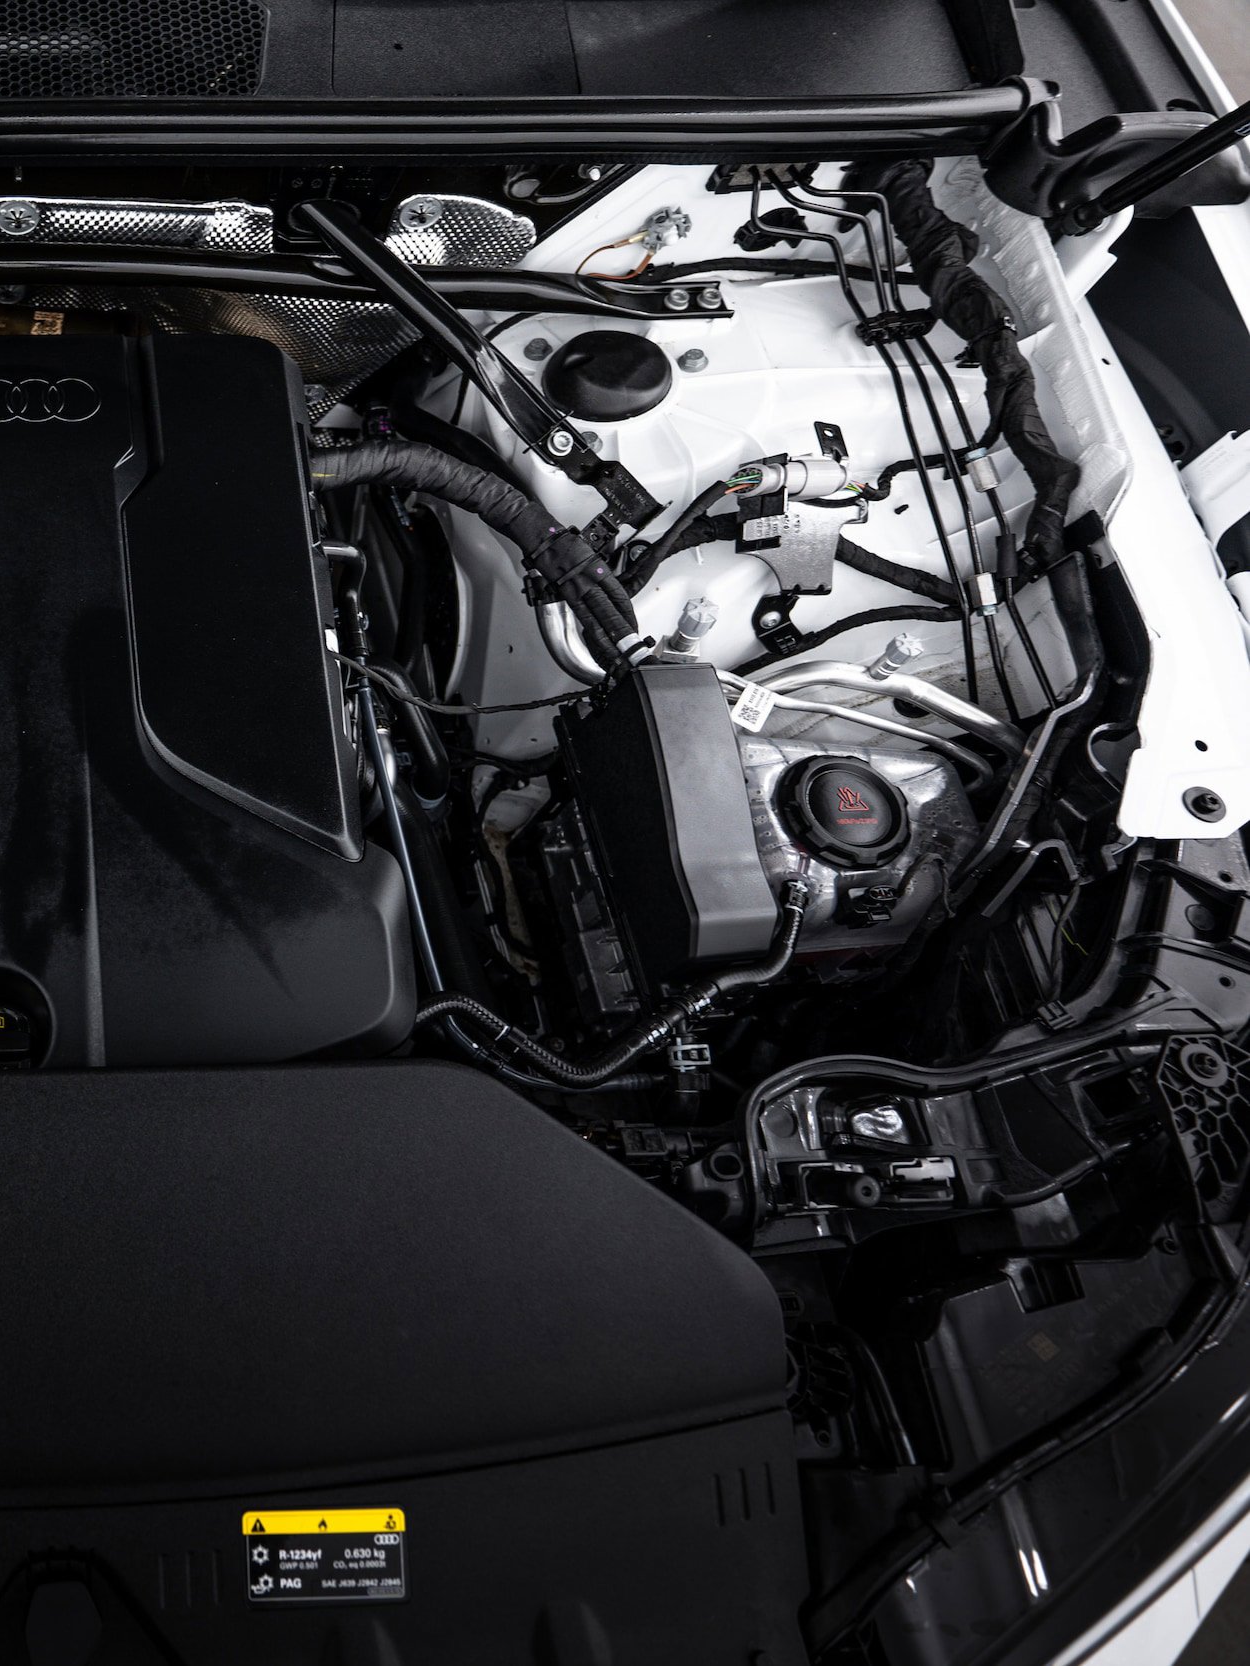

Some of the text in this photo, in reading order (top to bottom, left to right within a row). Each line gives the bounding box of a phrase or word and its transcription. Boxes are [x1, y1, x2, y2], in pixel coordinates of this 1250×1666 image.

[278, 1548, 386, 1560] R-1234yf 0.630 kg
[279, 1562, 297, 1570] GWP
[280, 1578, 302, 1589] PAG
[322, 1580, 336, 1588] SAE
